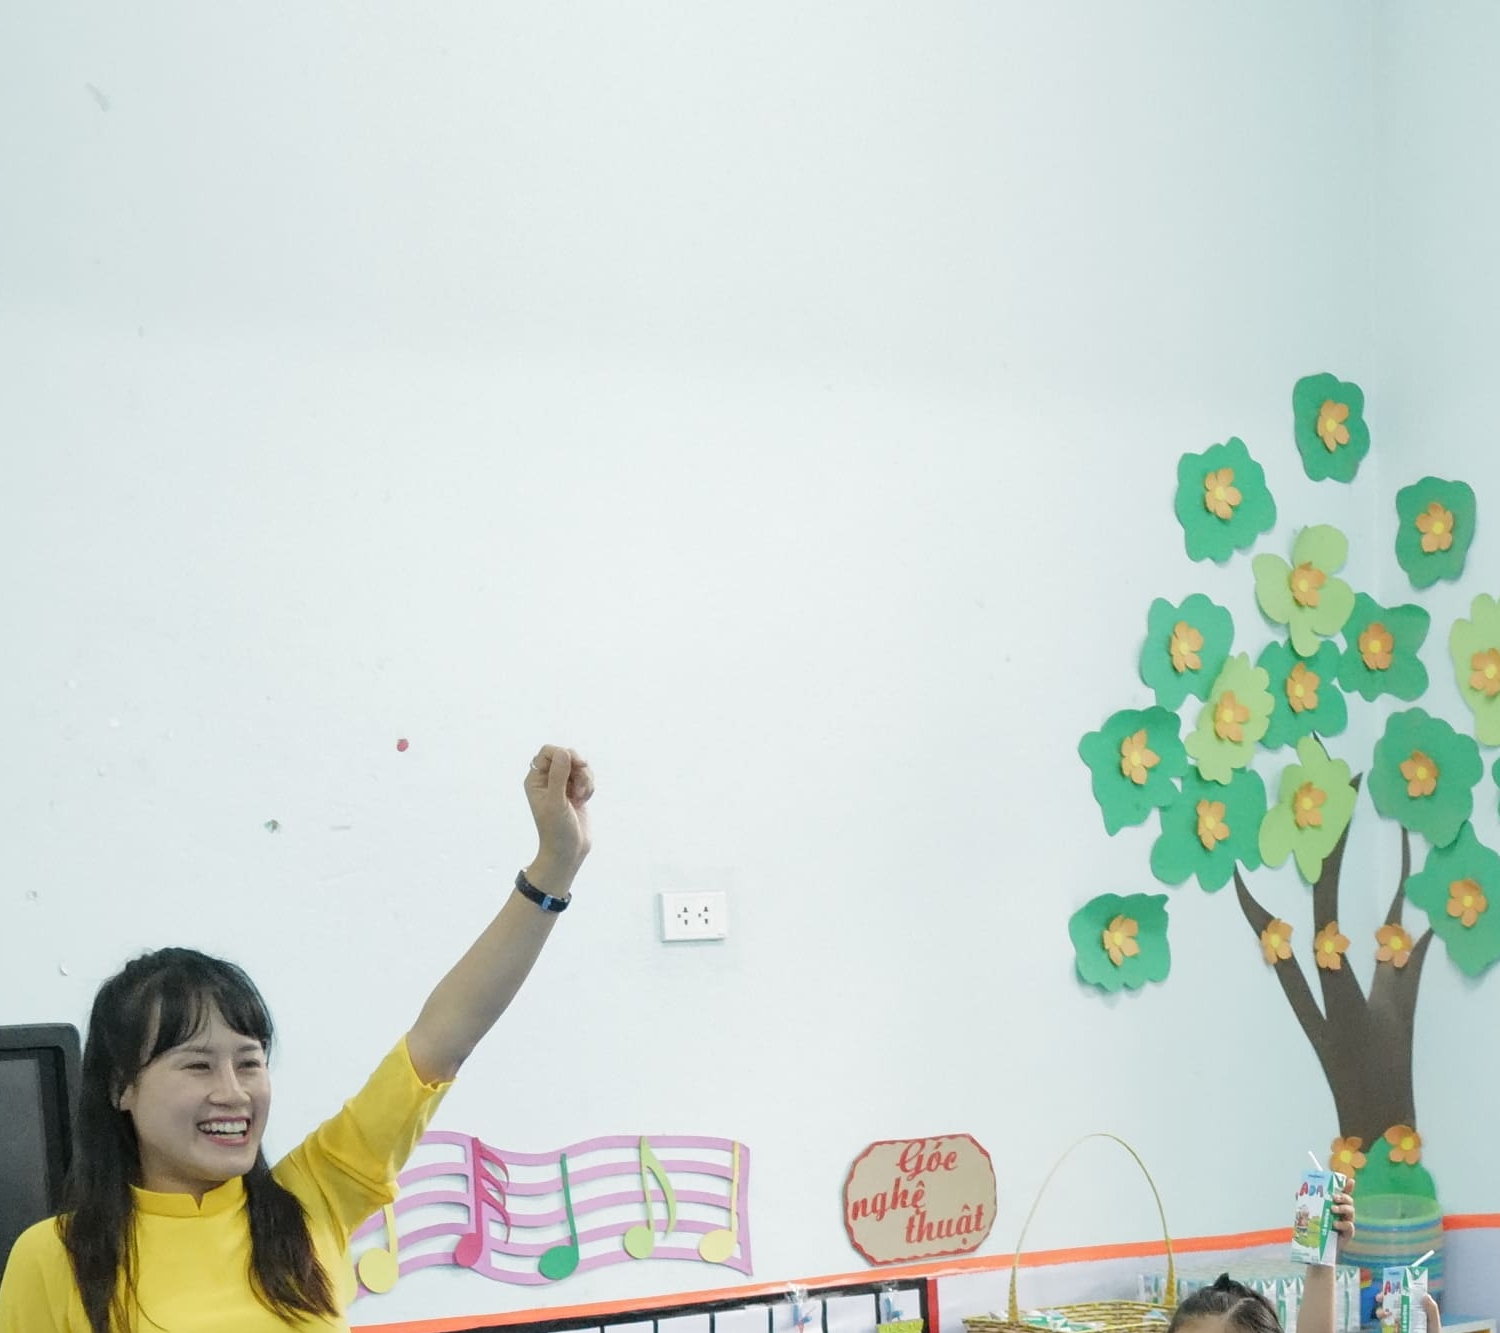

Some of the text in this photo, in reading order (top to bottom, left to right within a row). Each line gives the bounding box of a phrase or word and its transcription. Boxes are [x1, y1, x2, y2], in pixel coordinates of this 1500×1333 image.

[896, 1139, 958, 1181] Góc
[852, 1176, 926, 1222] nghệ
[906, 1204, 986, 1245] thuật
